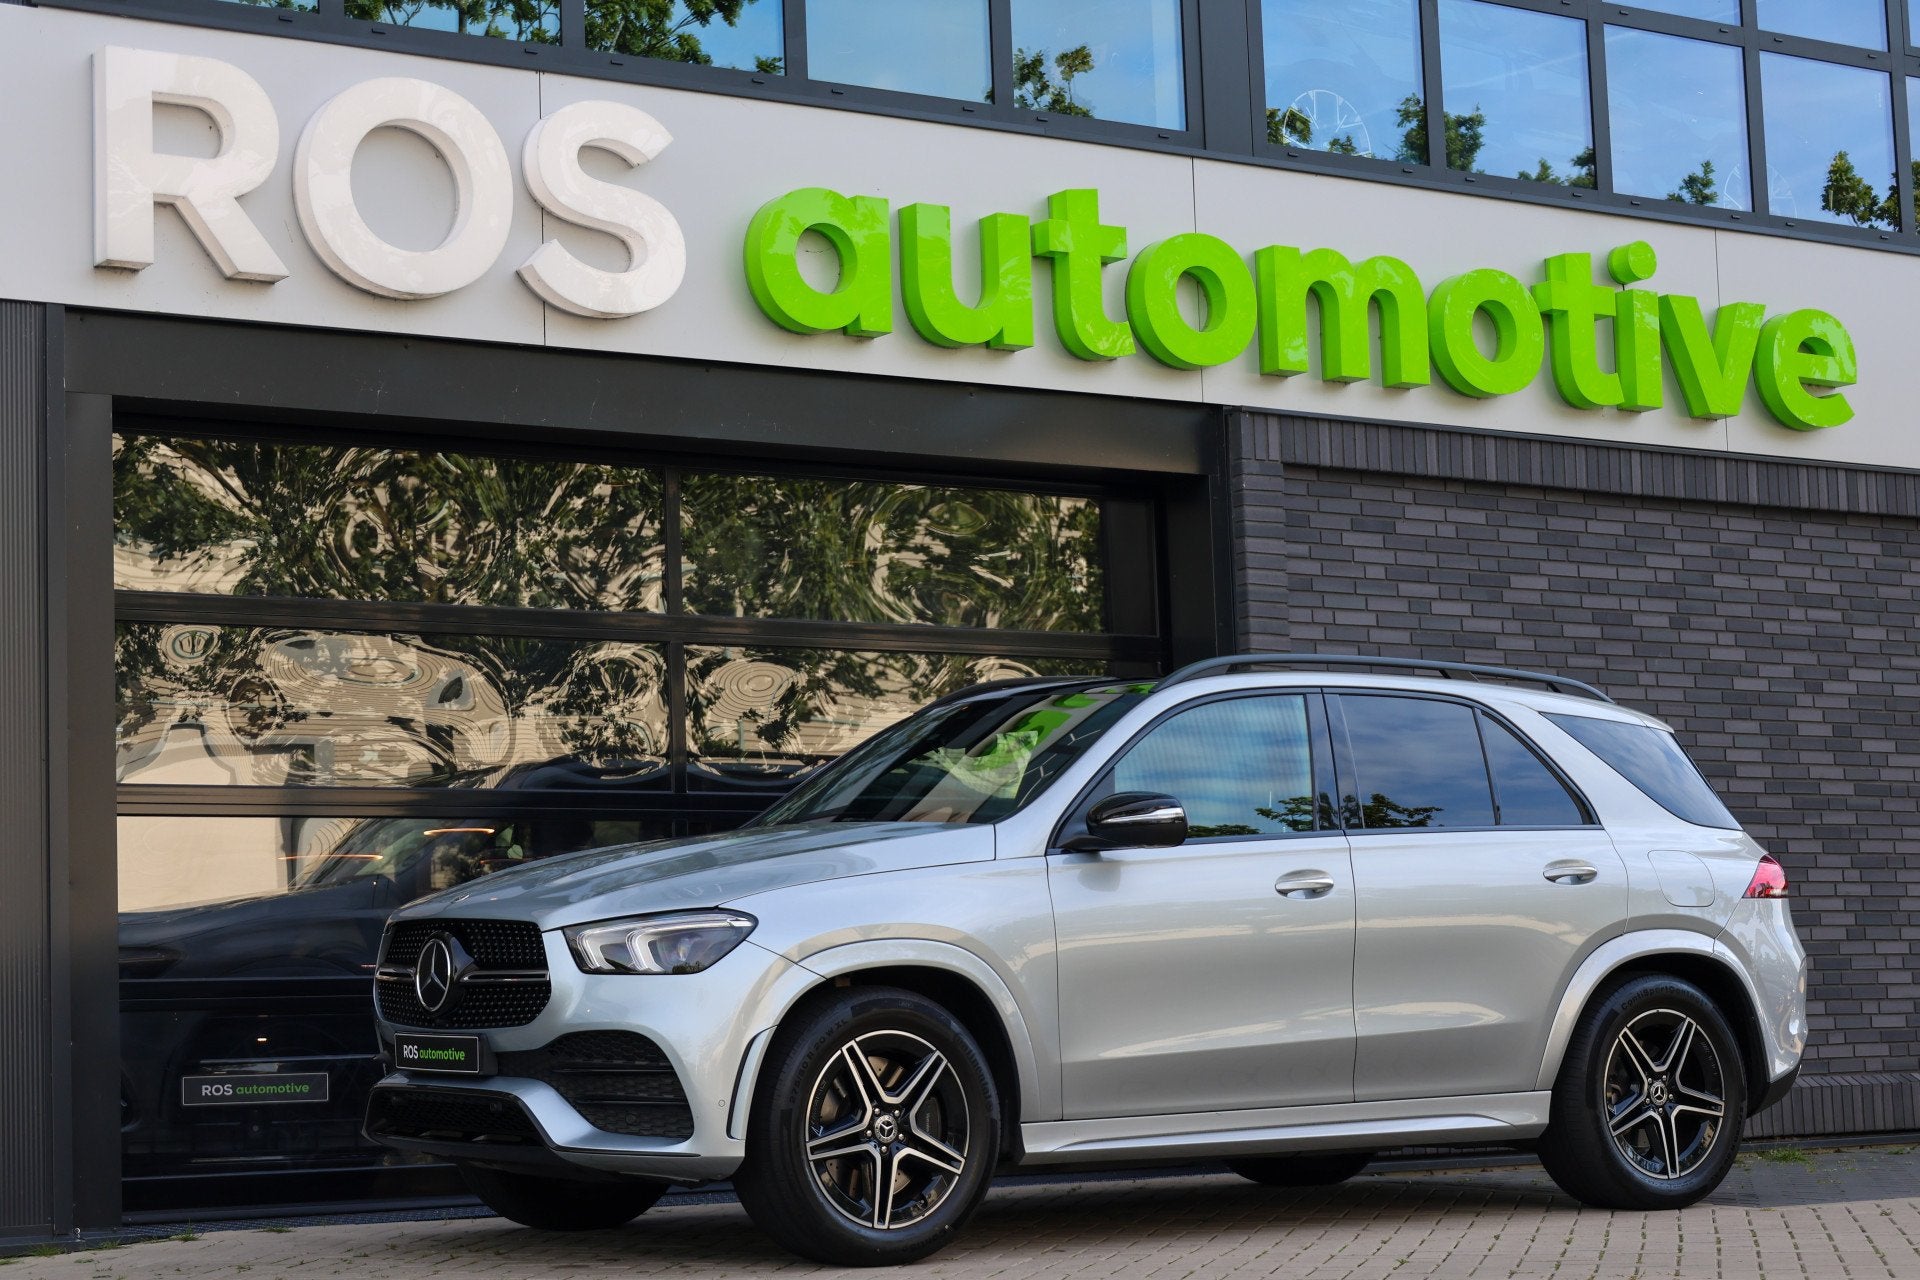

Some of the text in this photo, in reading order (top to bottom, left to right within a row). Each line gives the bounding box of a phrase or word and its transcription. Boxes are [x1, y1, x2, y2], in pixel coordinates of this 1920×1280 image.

[92, 44, 1858, 431] ROS automotive
[403, 1044, 465, 1060] ROS automotive
[201, 1083, 310, 1096] ROS automotive
